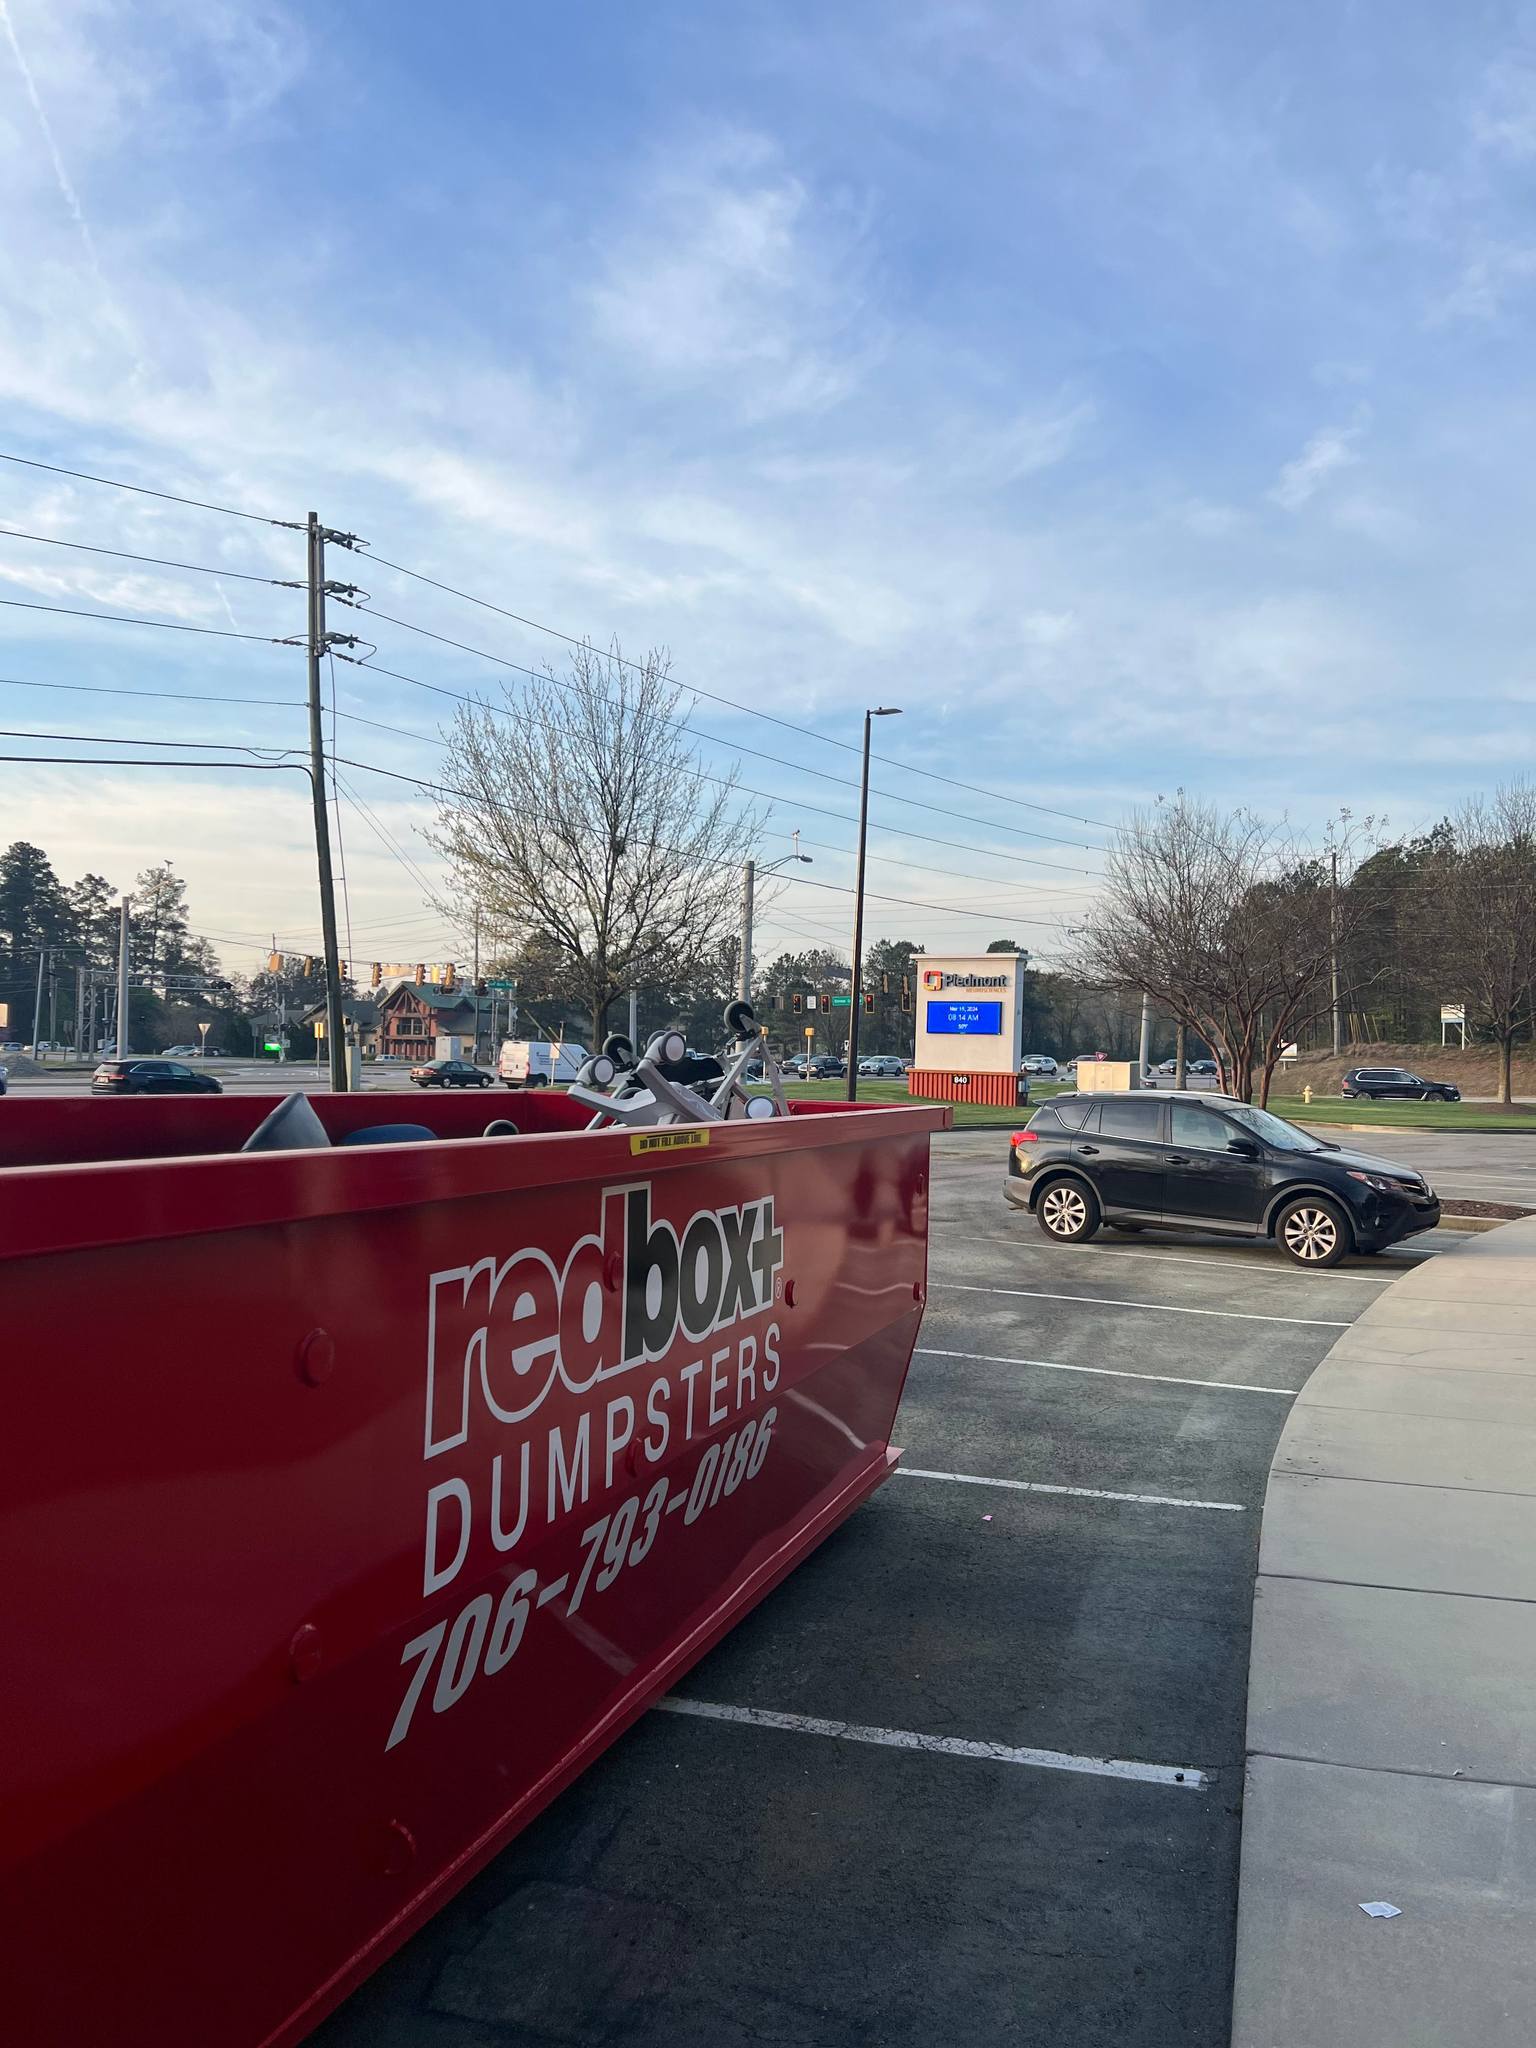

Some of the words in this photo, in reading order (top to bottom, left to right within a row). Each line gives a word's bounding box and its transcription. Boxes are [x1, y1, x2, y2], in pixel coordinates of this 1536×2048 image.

[945, 974, 1007, 987] Piedmont
[954, 1076, 968, 1084] 840
[423, 1323, 782, 1598] DUMPSTERS
[385, 1407, 777, 1753] 706-793-0186
